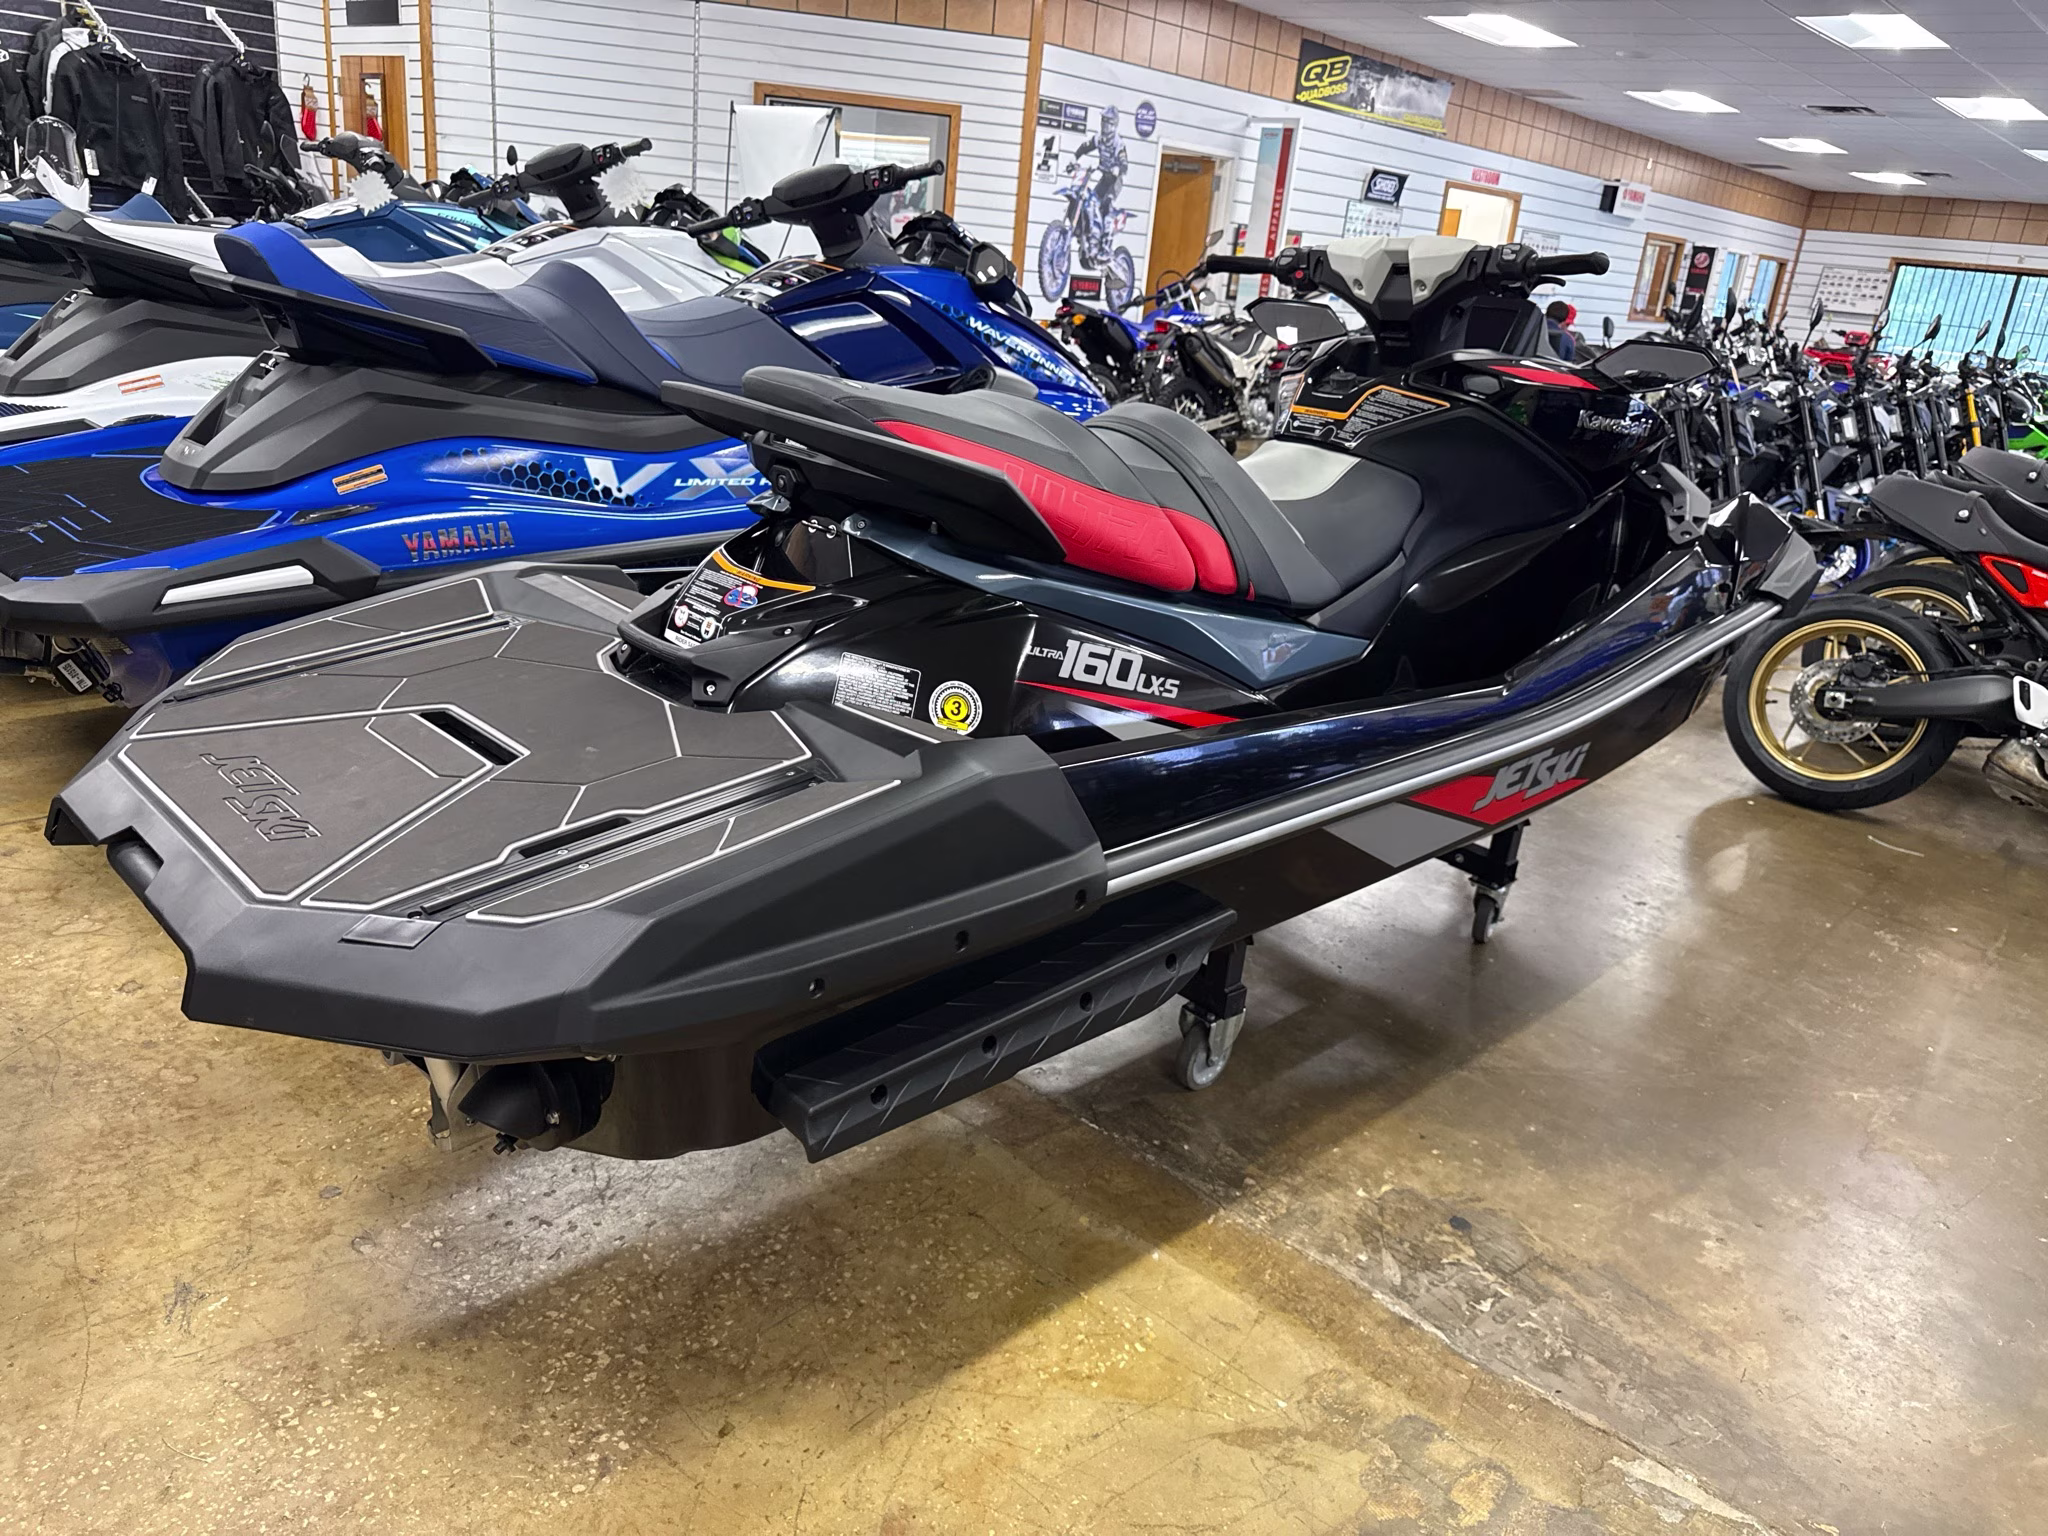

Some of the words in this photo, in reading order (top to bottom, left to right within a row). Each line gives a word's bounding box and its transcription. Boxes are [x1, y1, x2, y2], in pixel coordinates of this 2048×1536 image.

[1301, 55, 1352, 87] QB
[1300, 82, 1349, 102] QUADBOSS
[1374, 177, 1398, 195] SHOEI
[1269, 187, 1283, 241] APPAREL
[970, 316, 1076, 387] WAVERUNNER
[1577, 409, 1653, 437] Kawasaki
[674, 477, 755, 488] LIMITED
[401, 520, 516, 562] YAMAHA
[1026, 645, 1064, 660] ULTRA
[1058, 639, 1143, 691] 160
[1136, 673, 1180, 699] LX-S
[950, 700, 962, 717] 3
